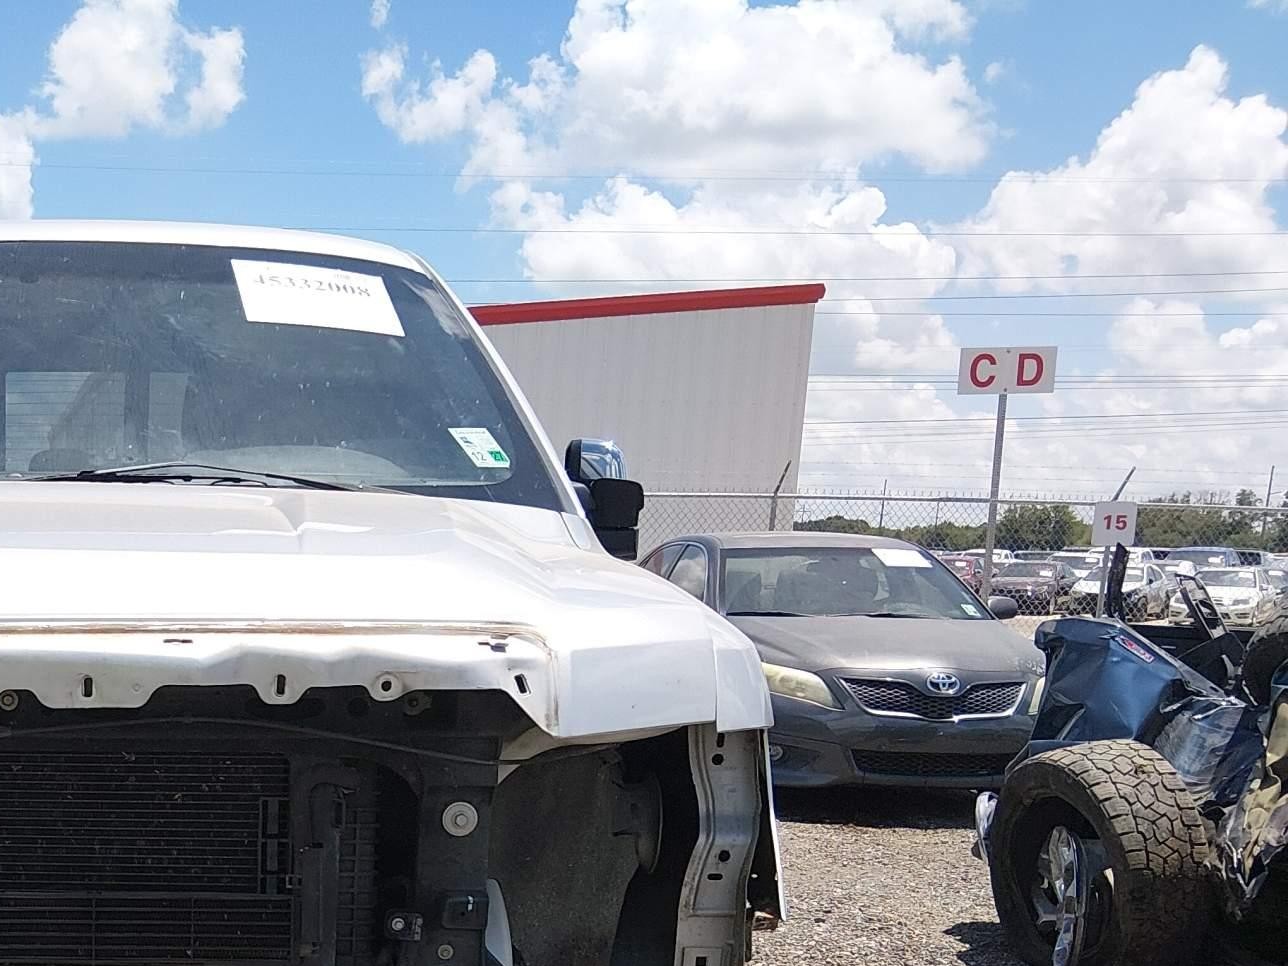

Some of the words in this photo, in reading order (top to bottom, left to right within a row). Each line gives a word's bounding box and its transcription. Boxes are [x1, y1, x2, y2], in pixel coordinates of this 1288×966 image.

[969, 353, 997, 388] C
[1016, 352, 1044, 387] D
[1103, 514, 1128, 531] 15
